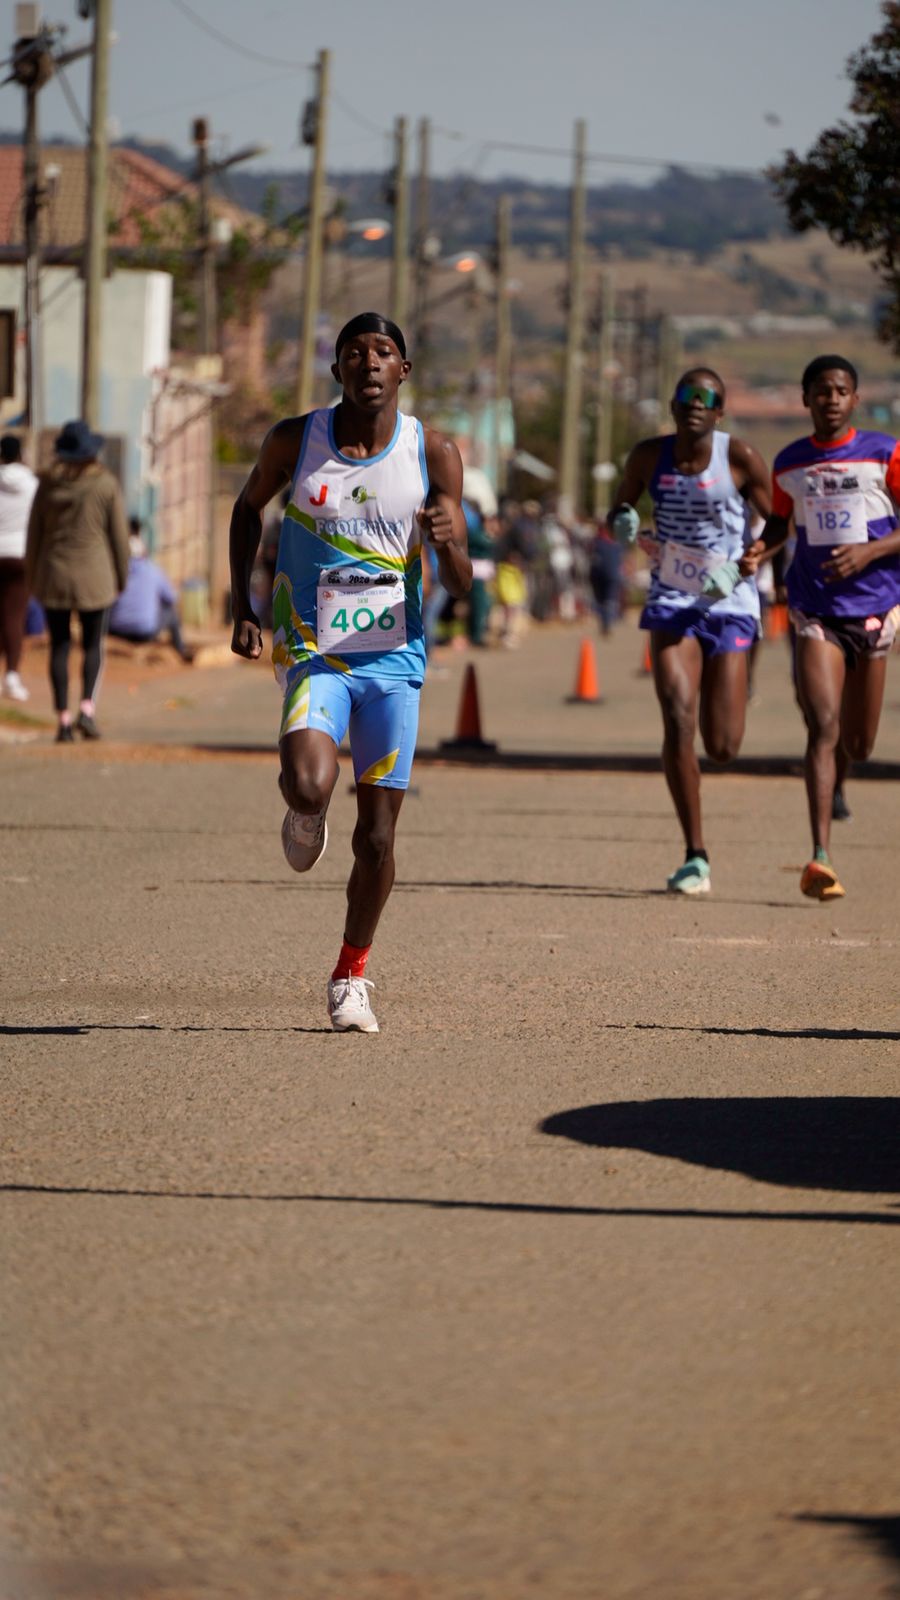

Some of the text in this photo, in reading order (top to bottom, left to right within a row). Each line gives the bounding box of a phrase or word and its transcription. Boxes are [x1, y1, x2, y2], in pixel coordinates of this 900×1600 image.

[309, 484, 328, 507] J
[816, 510, 852, 531] 182
[330, 607, 396, 633] 406
